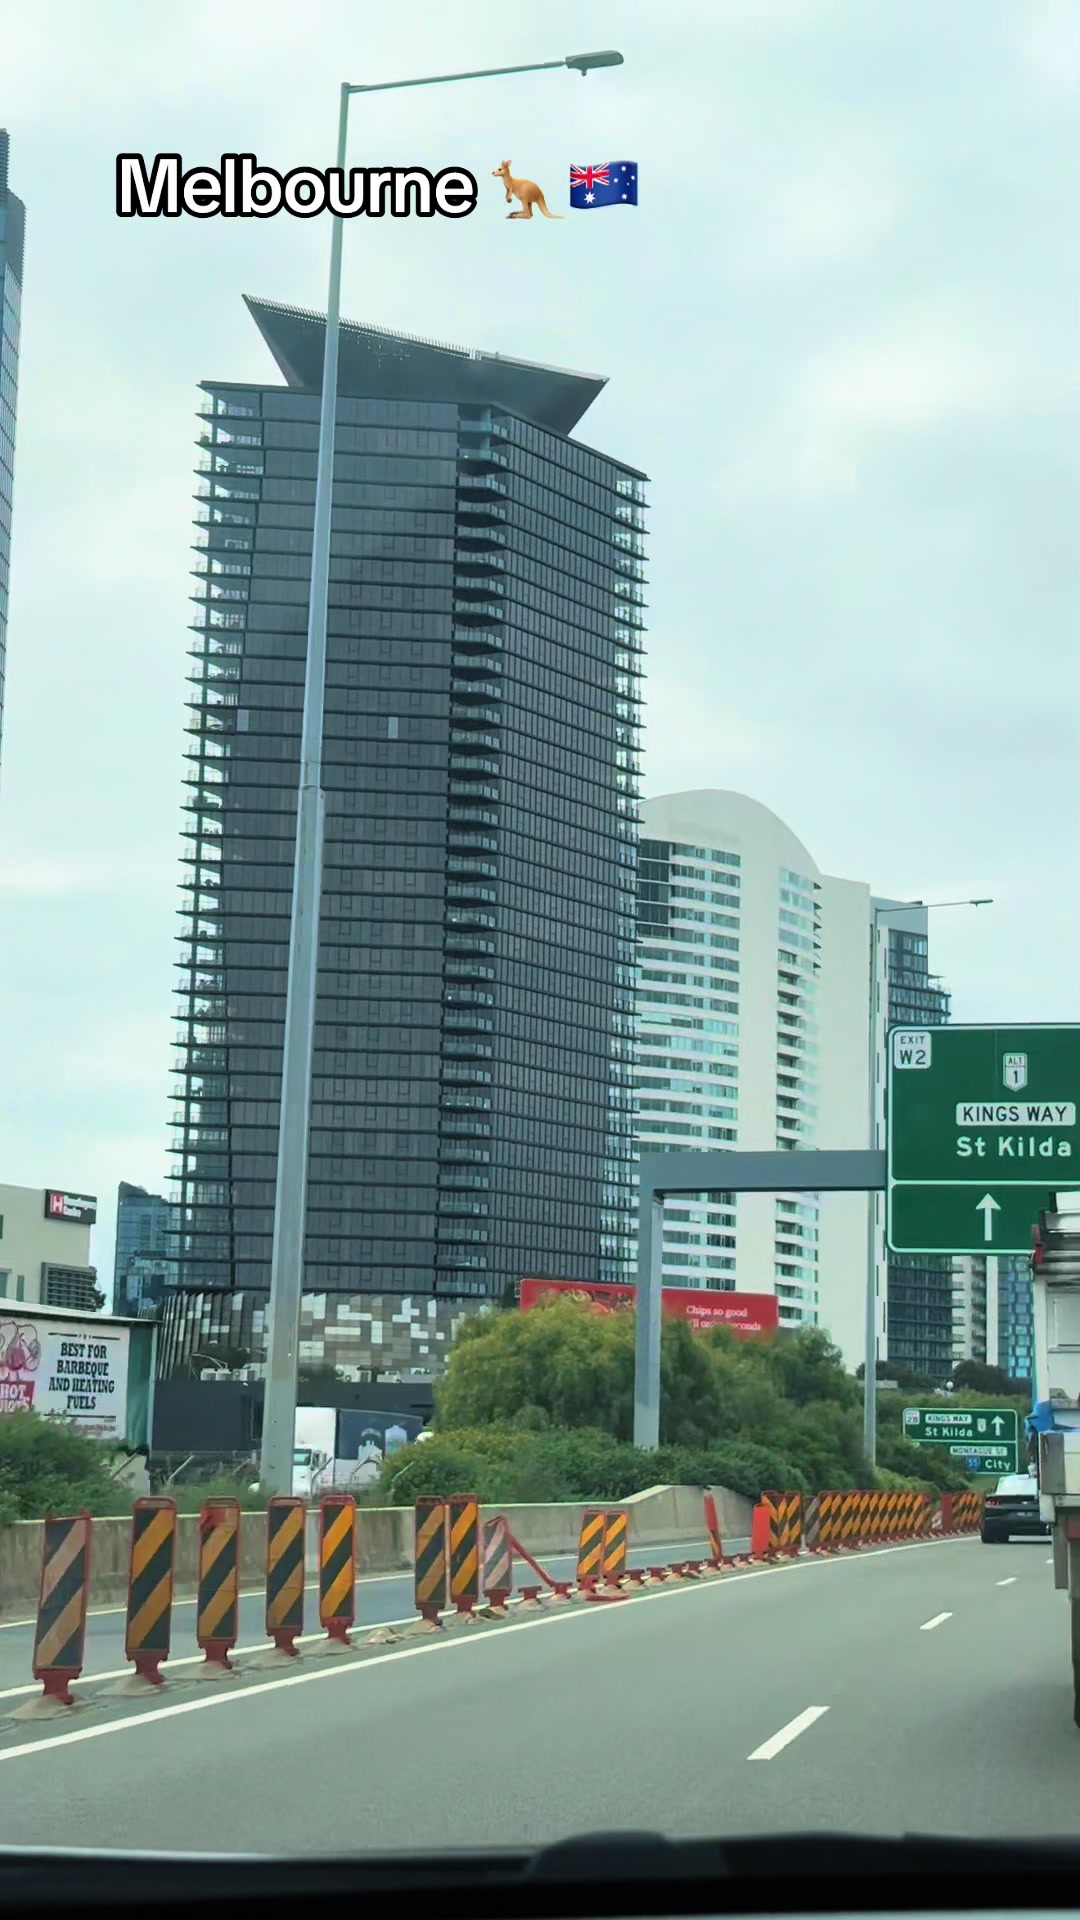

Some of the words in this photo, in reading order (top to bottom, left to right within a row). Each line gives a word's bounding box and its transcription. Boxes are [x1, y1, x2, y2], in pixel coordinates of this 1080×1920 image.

[900, 1035, 925, 1045] EXIT
[899, 1049, 926, 1066] W2
[1008, 1056, 1023, 1065] ALT
[1013, 1069, 1018, 1084] 1
[963, 1106, 1020, 1122] KINGS
[1026, 1106, 1067, 1122] WAY
[956, 1136, 986, 1157] St
[998, 1136, 1072, 1157] Kilda
[686, 1305, 711, 1317] Chips
[713, 1308, 724, 1316] so
[725, 1308, 748, 1318] good
[60, 1342, 85, 1357] BEST
[87, 1344, 107, 1359] FOR
[57, 1360, 109, 1378] BARBEQUE
[49, 1377, 70, 1391] AND
[72, 1378, 115, 1394] HEATING
[67, 1395, 96, 1410] FUELS
[925, 1427, 938, 1436] St
[942, 1427, 973, 1437] Kilda
[985, 1459, 1011, 1470] City
